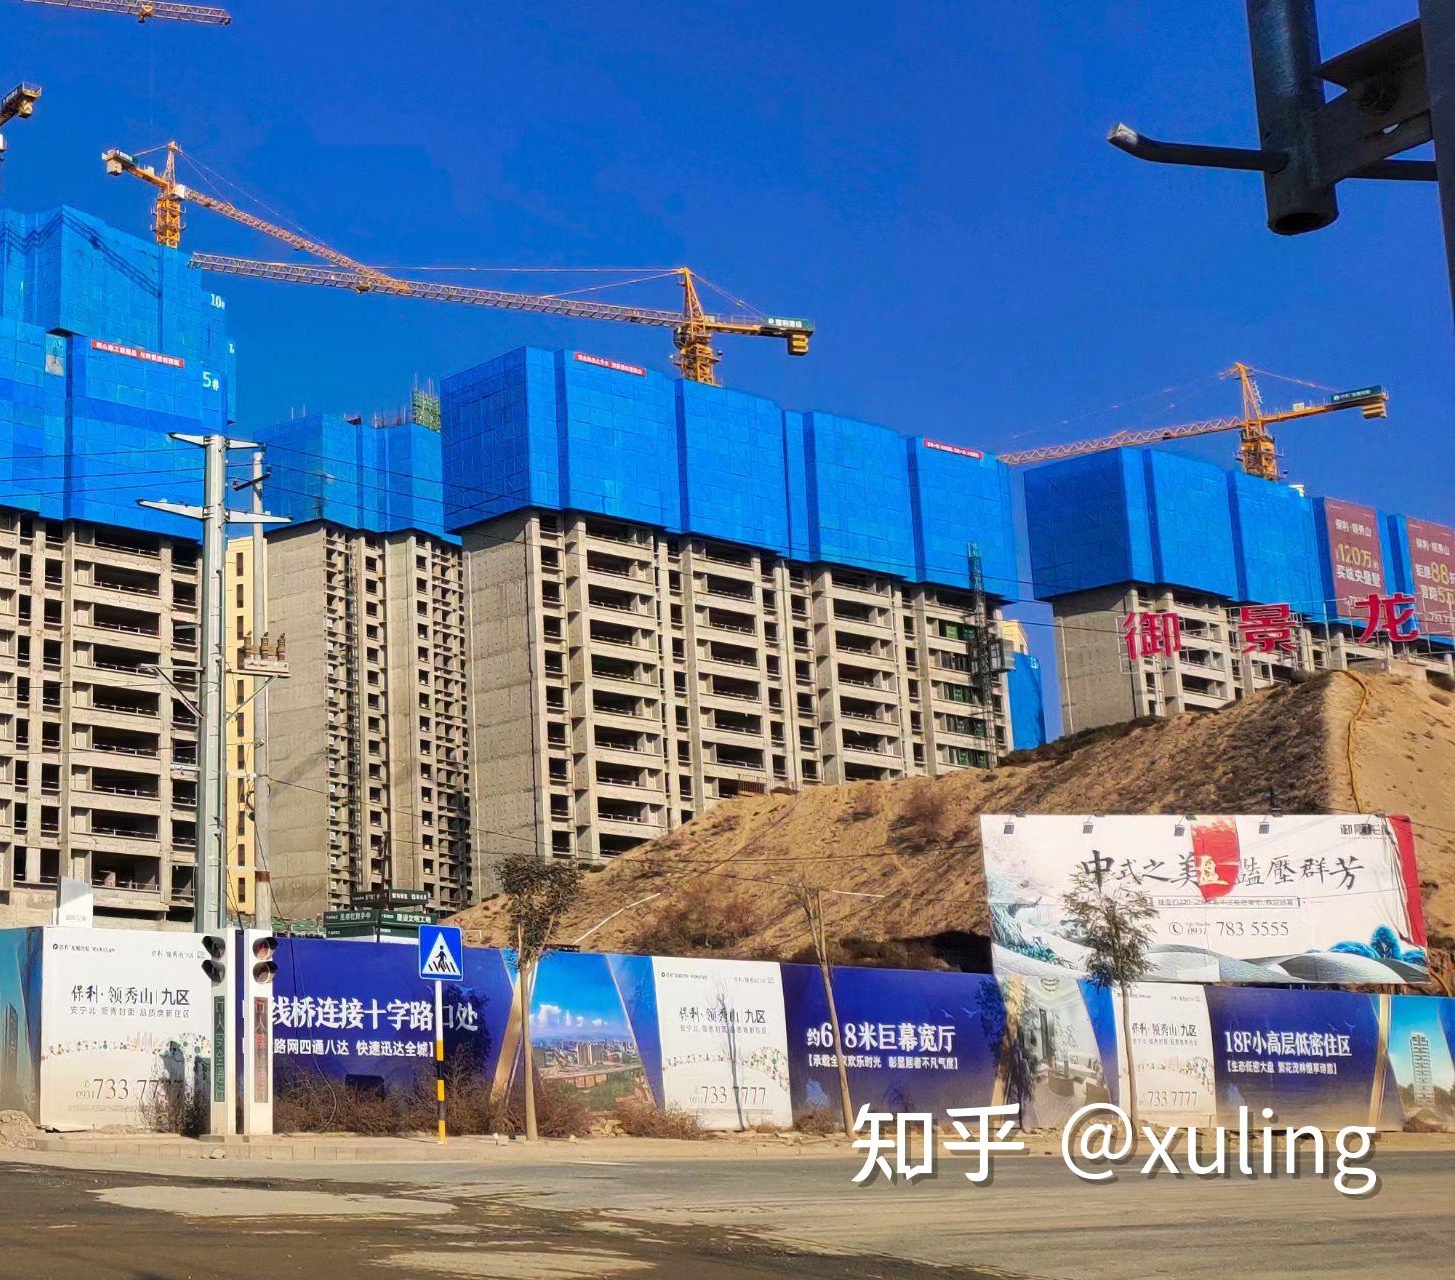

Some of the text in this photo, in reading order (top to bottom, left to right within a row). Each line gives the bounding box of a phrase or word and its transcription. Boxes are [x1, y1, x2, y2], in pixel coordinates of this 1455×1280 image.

[202, 371, 220, 391] 5#
[1216, 921, 1245, 937] 783
[1251, 921, 1289, 937] 5555
[243, 996, 479, 1032] 线桥连接十字路口处
[806, 1021, 956, 1053] 约68米巨幕宽厅
[1224, 1030, 1352, 1057] 18F小高层低密住区
[93, 1078, 129, 1100] 733
[701, 1086, 727, 1104] 733
